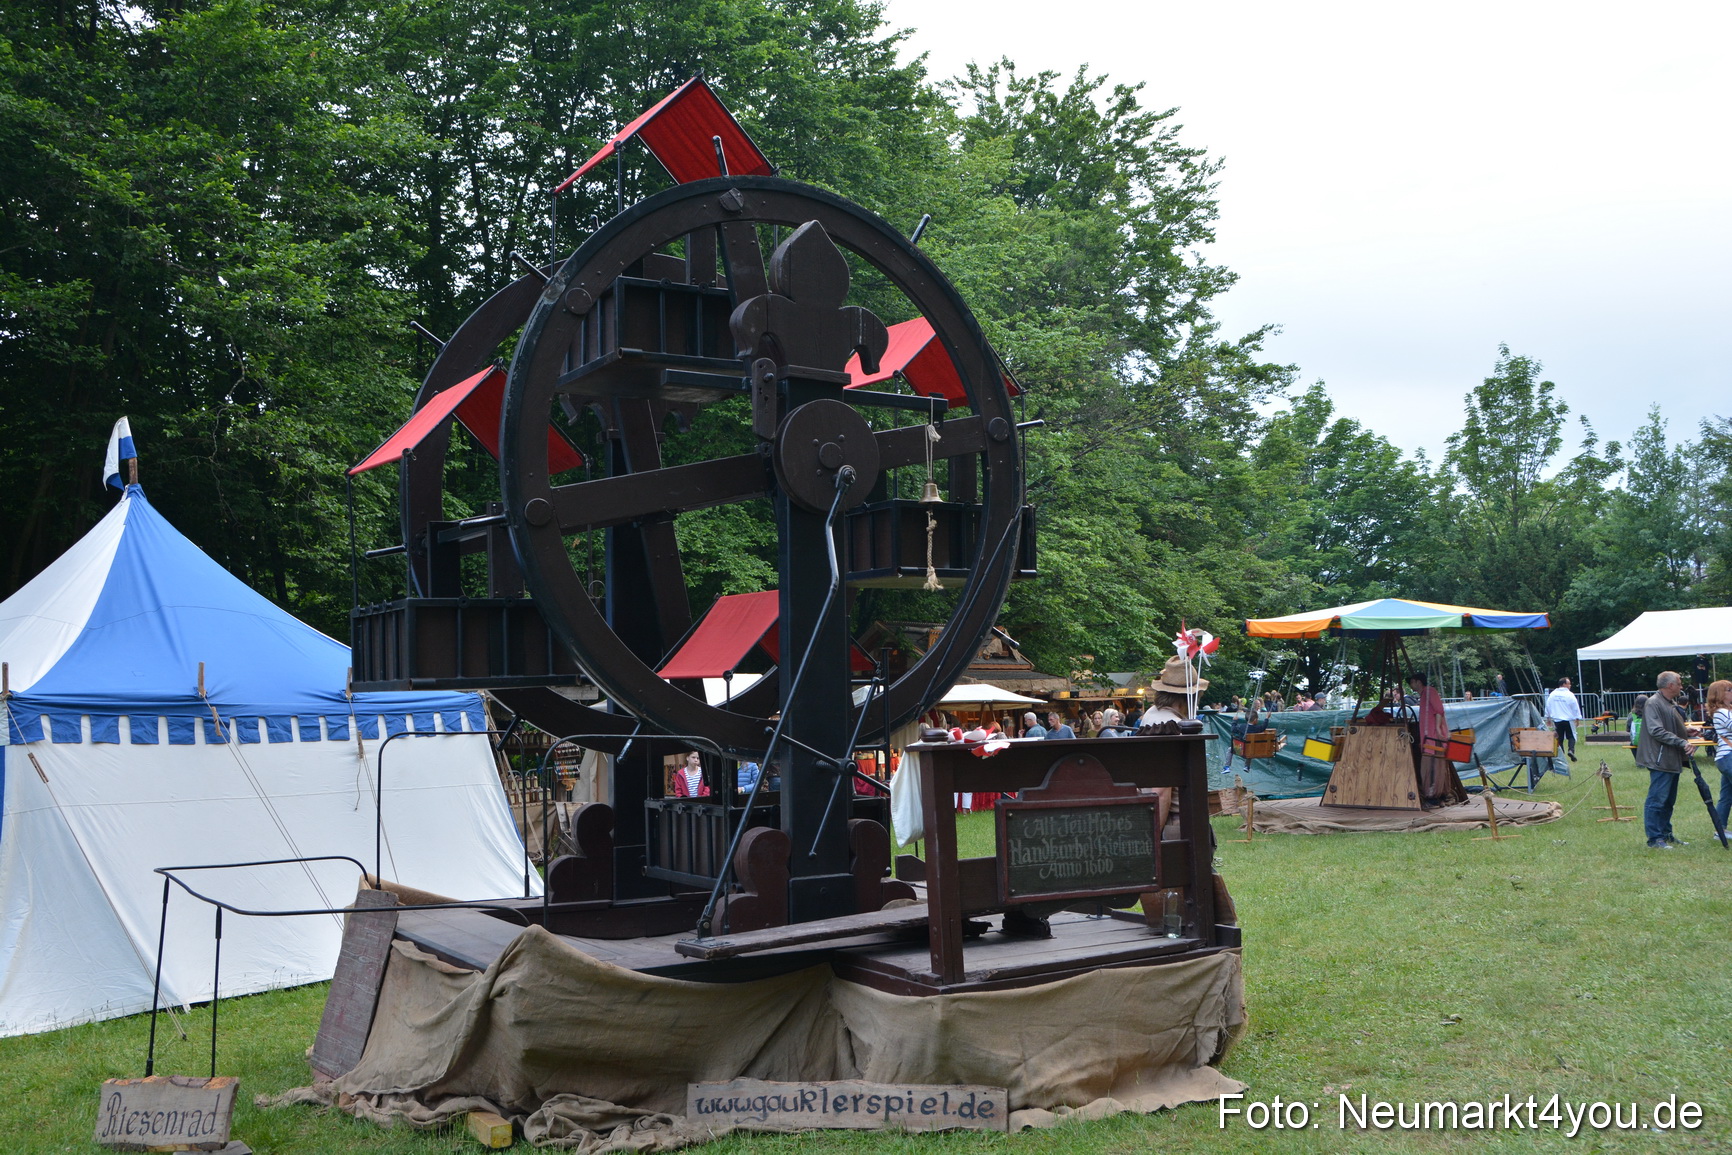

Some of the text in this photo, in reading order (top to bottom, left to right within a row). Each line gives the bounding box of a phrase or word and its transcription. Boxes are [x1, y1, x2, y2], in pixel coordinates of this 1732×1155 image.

[1023, 816, 1057, 838] Alt
[1040, 858, 1114, 879] Anno 1600
[101, 1091, 221, 1138] Riesenrad
[694, 1087, 996, 1124] www.gauklerspiel.de
